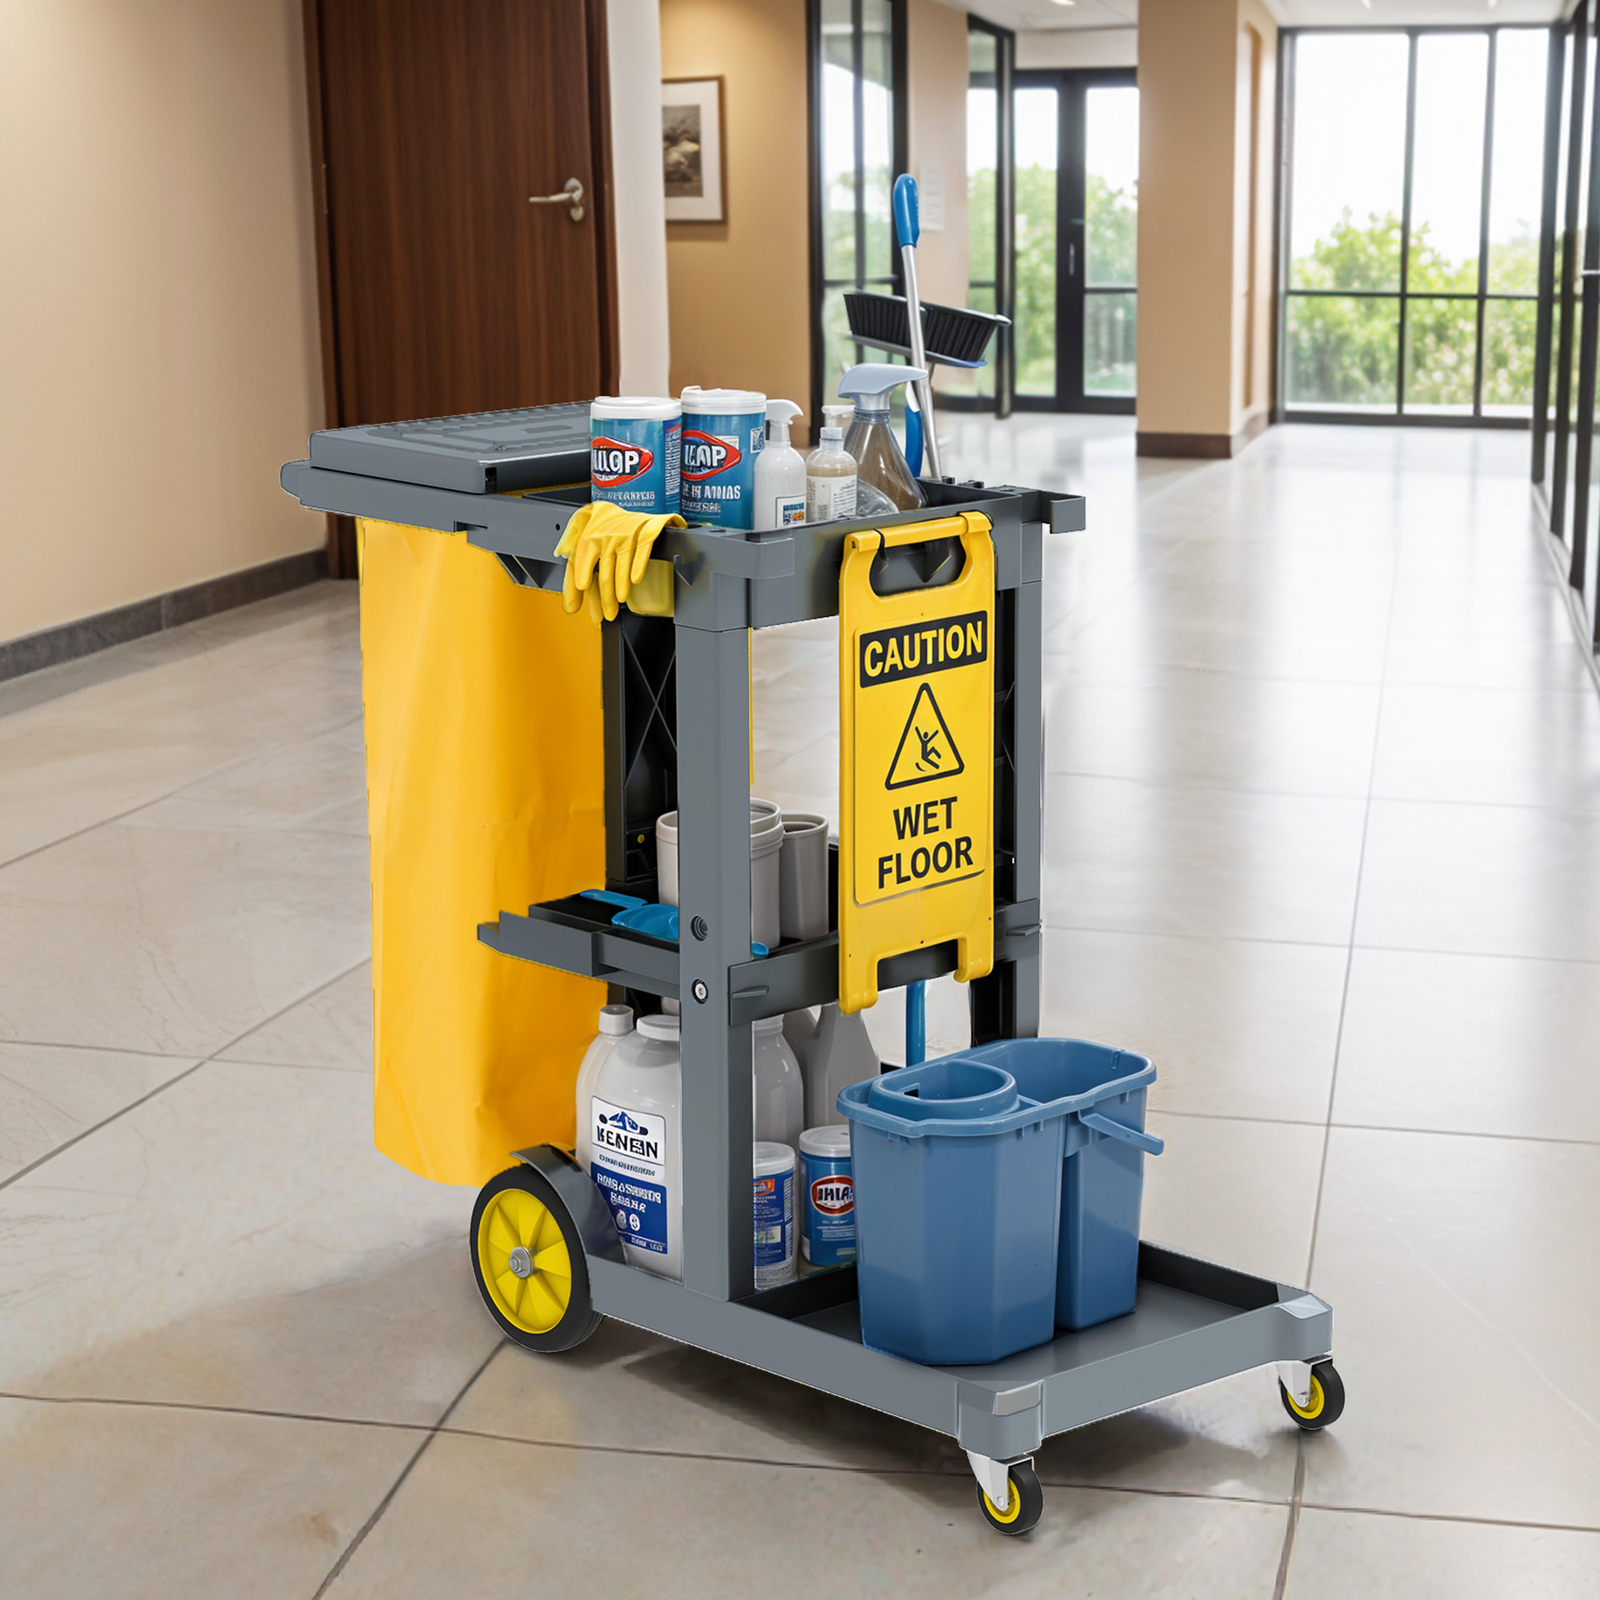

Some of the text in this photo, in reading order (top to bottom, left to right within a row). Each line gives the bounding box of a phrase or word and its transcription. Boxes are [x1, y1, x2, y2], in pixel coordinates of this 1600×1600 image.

[864, 621, 983, 678] CAUTION
[893, 796, 958, 840] WET
[877, 836, 974, 889] FLOOR
